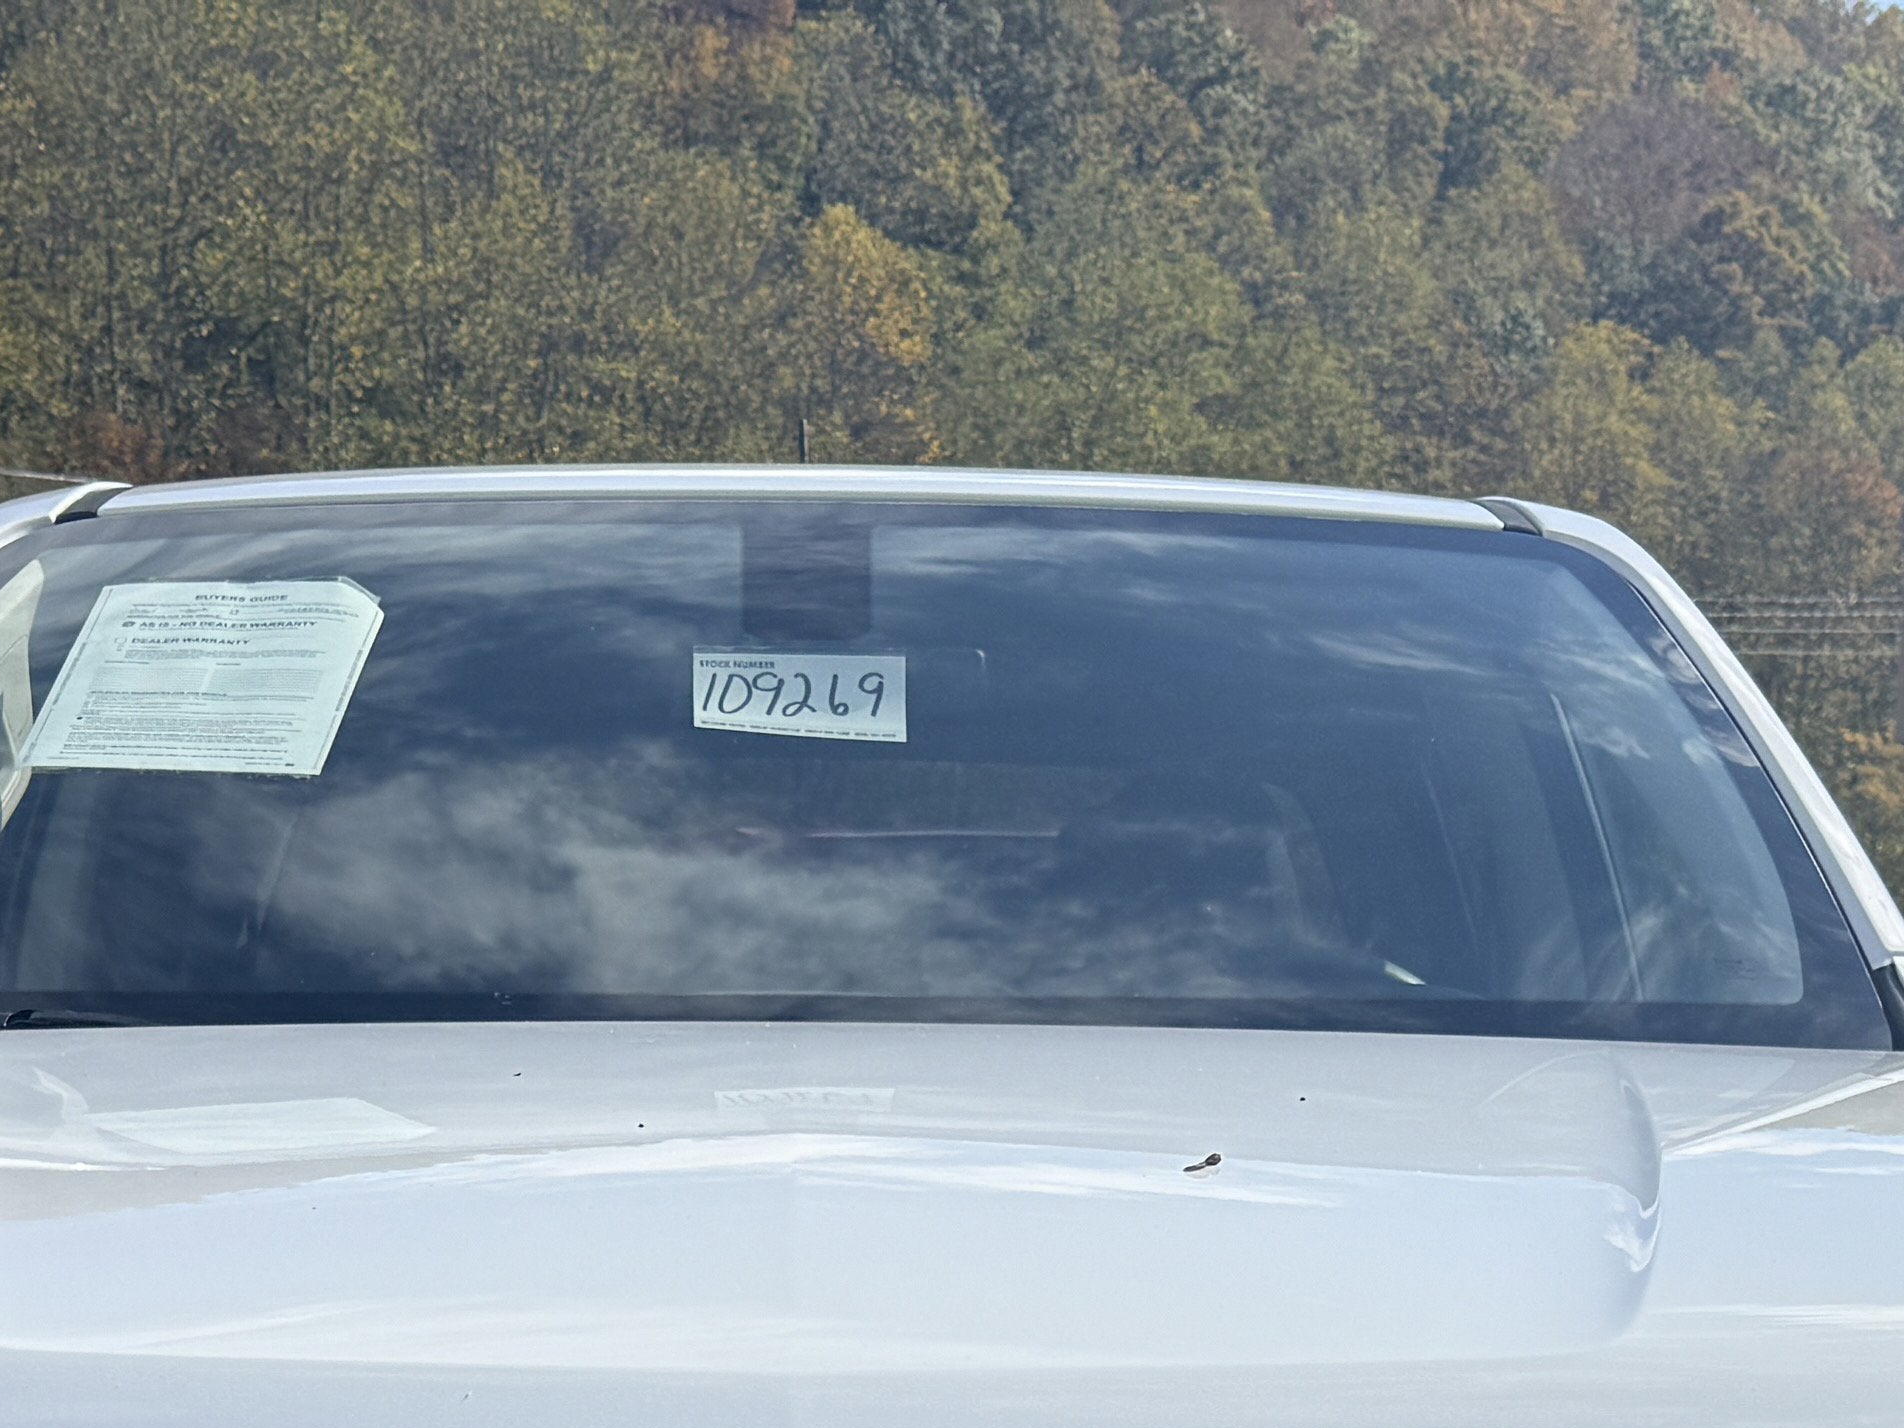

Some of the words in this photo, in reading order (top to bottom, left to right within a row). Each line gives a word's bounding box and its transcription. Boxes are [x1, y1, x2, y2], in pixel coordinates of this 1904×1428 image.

[249, 620, 318, 629] WARRANTY
[131, 637, 179, 645] DEALER
[700, 659, 731, 668] STOCK
[702, 671, 885, 717] 109269
